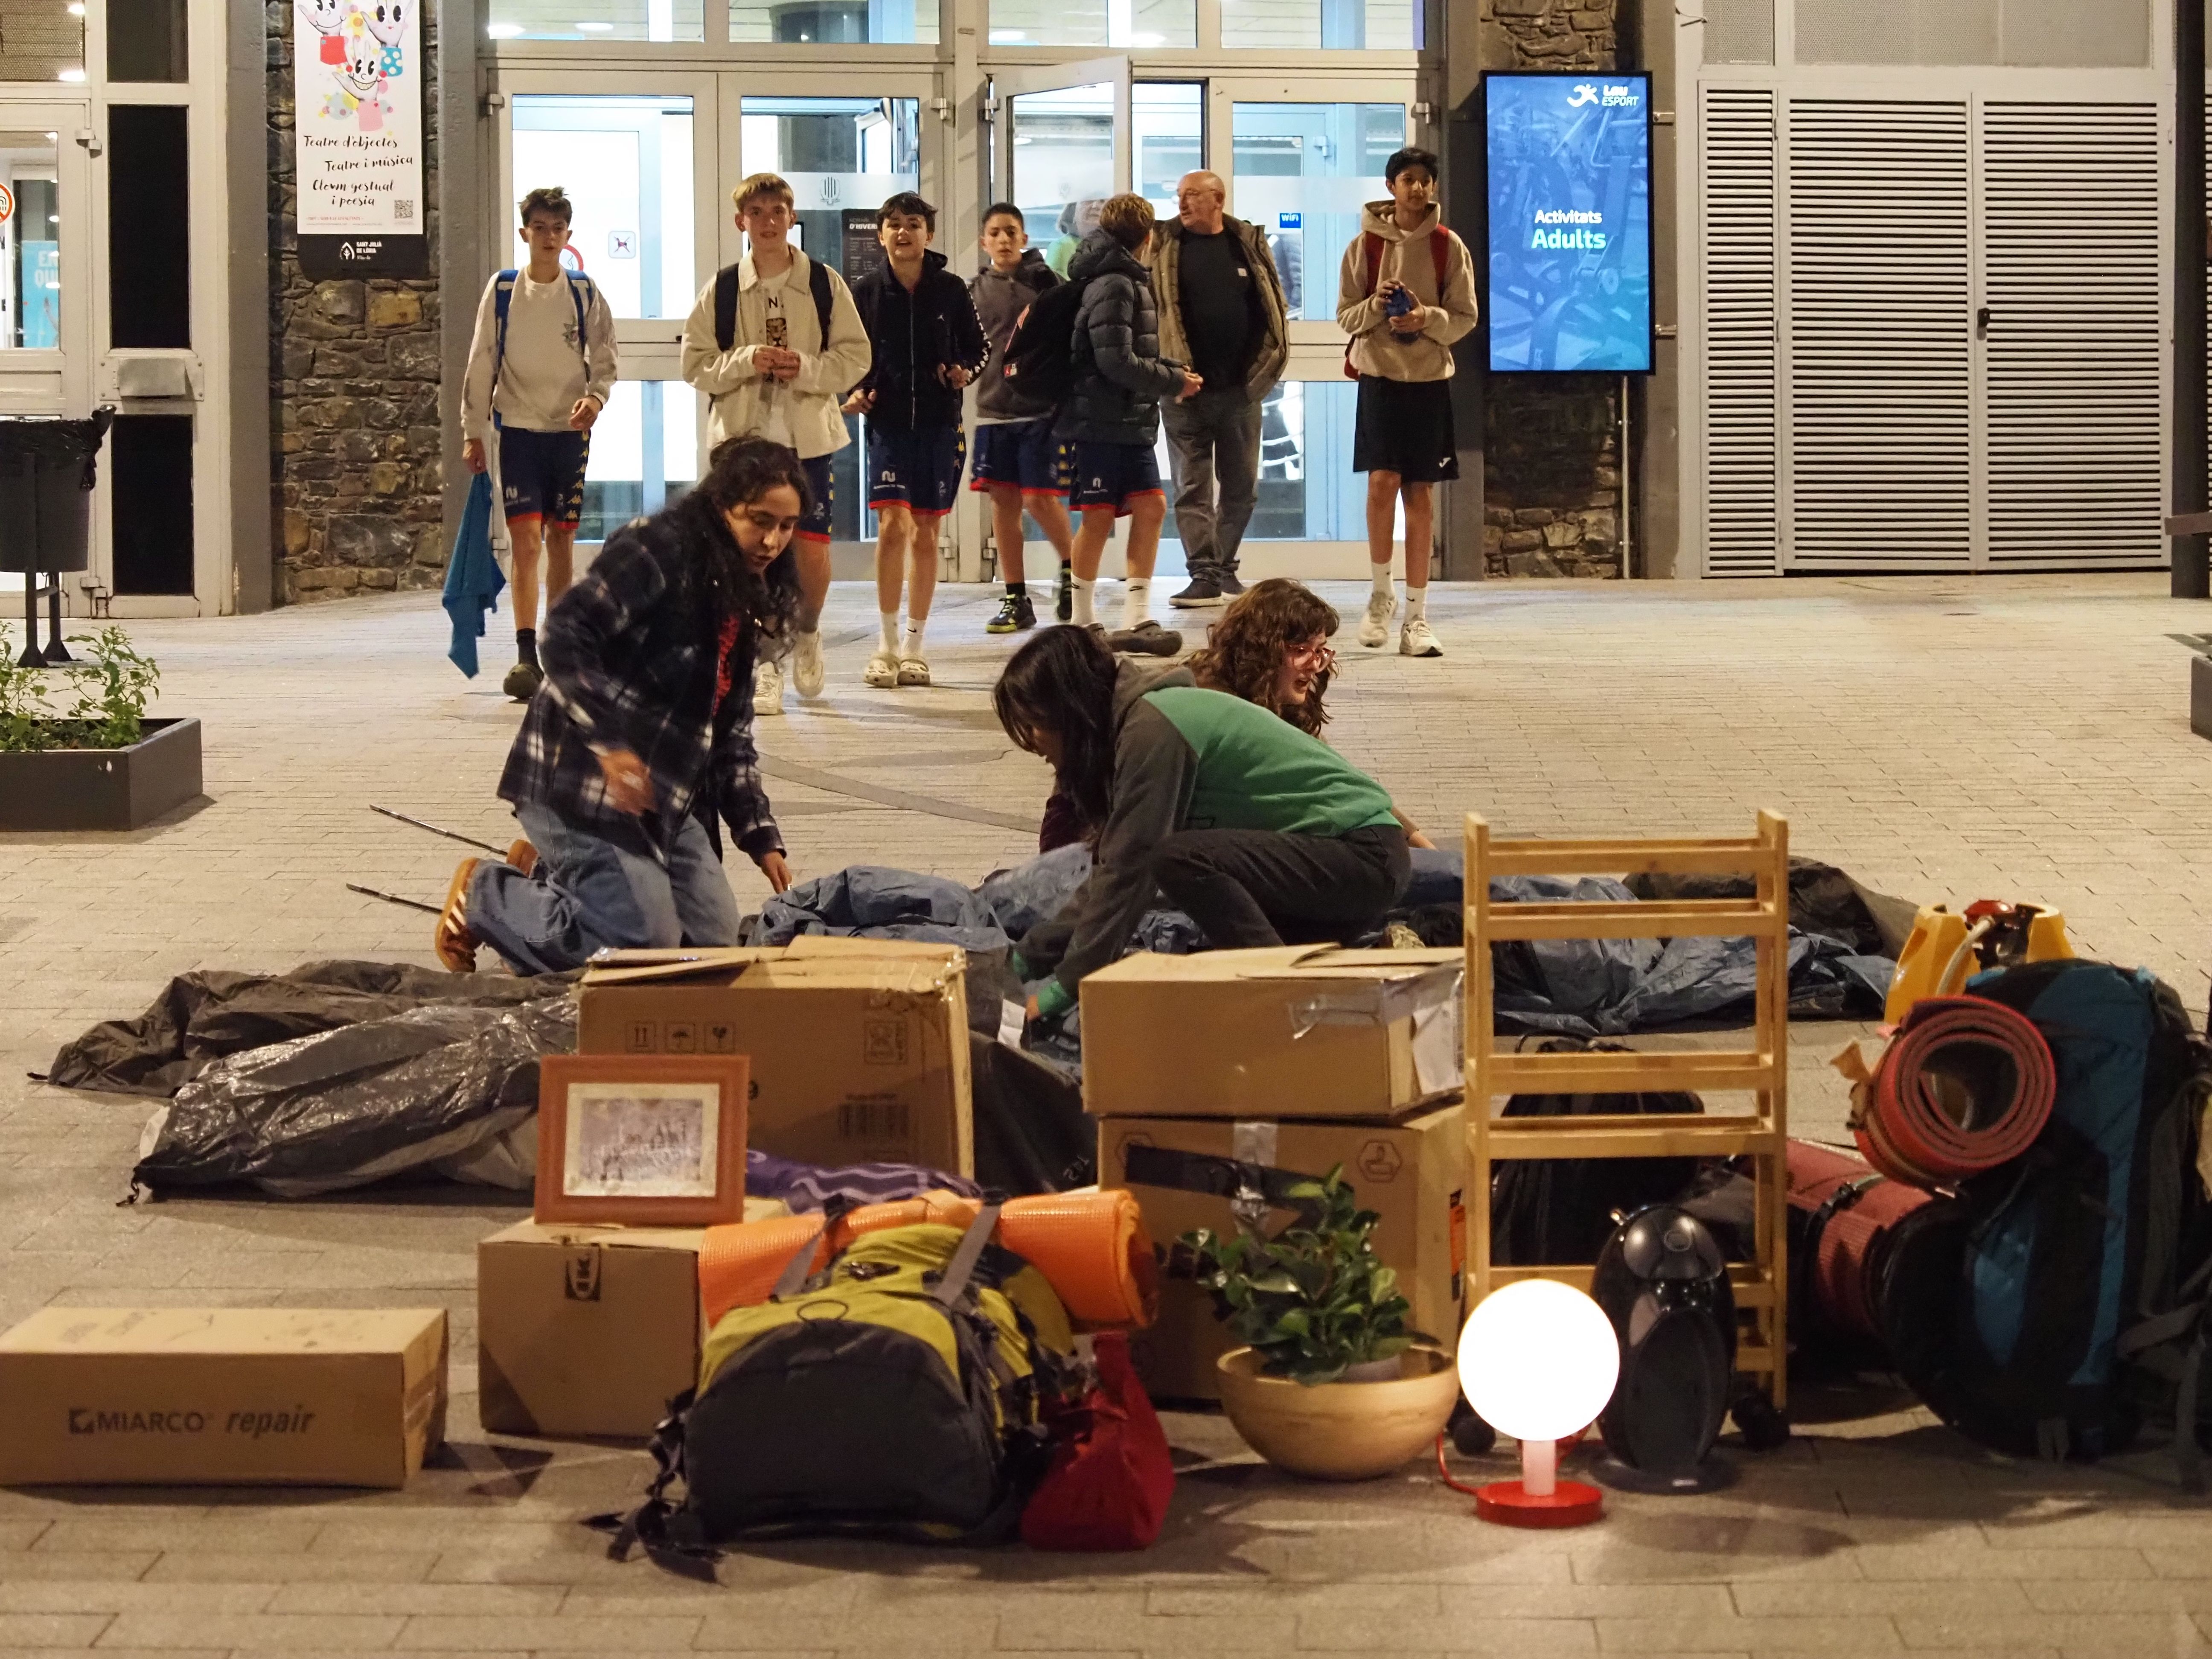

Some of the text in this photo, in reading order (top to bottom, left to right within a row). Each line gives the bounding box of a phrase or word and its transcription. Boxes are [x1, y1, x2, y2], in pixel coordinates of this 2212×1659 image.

[1602, 96, 1639, 106] ESPORT
[303, 135, 398, 150] Teatre d'objectes
[325, 155, 413, 172] Teatre i música
[313, 179, 394, 193] Clown gestual
[332, 195, 375, 207] i poesia
[1534, 210, 1602, 224] Activitats
[1531, 229, 1606, 249] Adults
[97, 1404, 316, 1439] MIARCO repair
